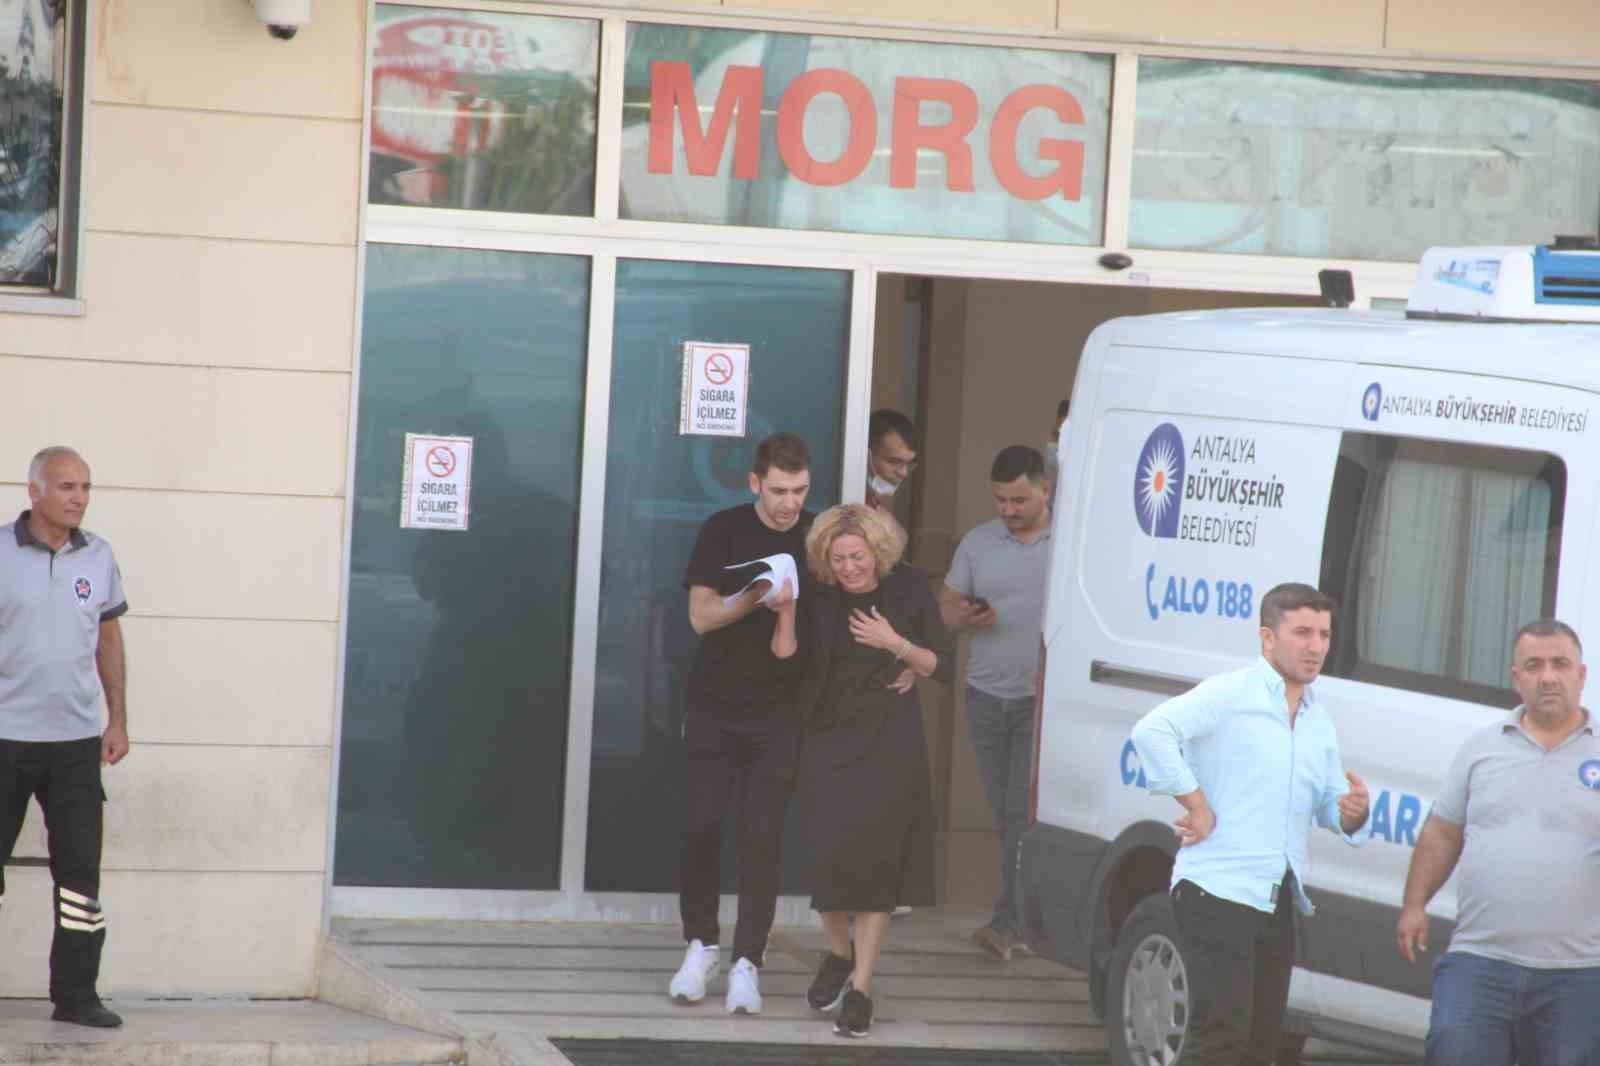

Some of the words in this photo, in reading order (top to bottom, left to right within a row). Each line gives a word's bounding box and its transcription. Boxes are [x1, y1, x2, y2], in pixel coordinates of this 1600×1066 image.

[647, 60, 1086, 201] MORG
[1382, 395, 1433, 417] ANTALYA
[1435, 394, 1517, 426] BÜYÜKŞEHİR
[1519, 407, 1589, 433] BELEDİYESİ
[1190, 435, 1256, 464] ANTALYA
[1186, 467, 1285, 511] BÜYÜKŞEHİR
[1180, 512, 1259, 547] BELEDİYESİ
[1162, 576, 1209, 614] ALO
[1215, 581, 1253, 619] 188
